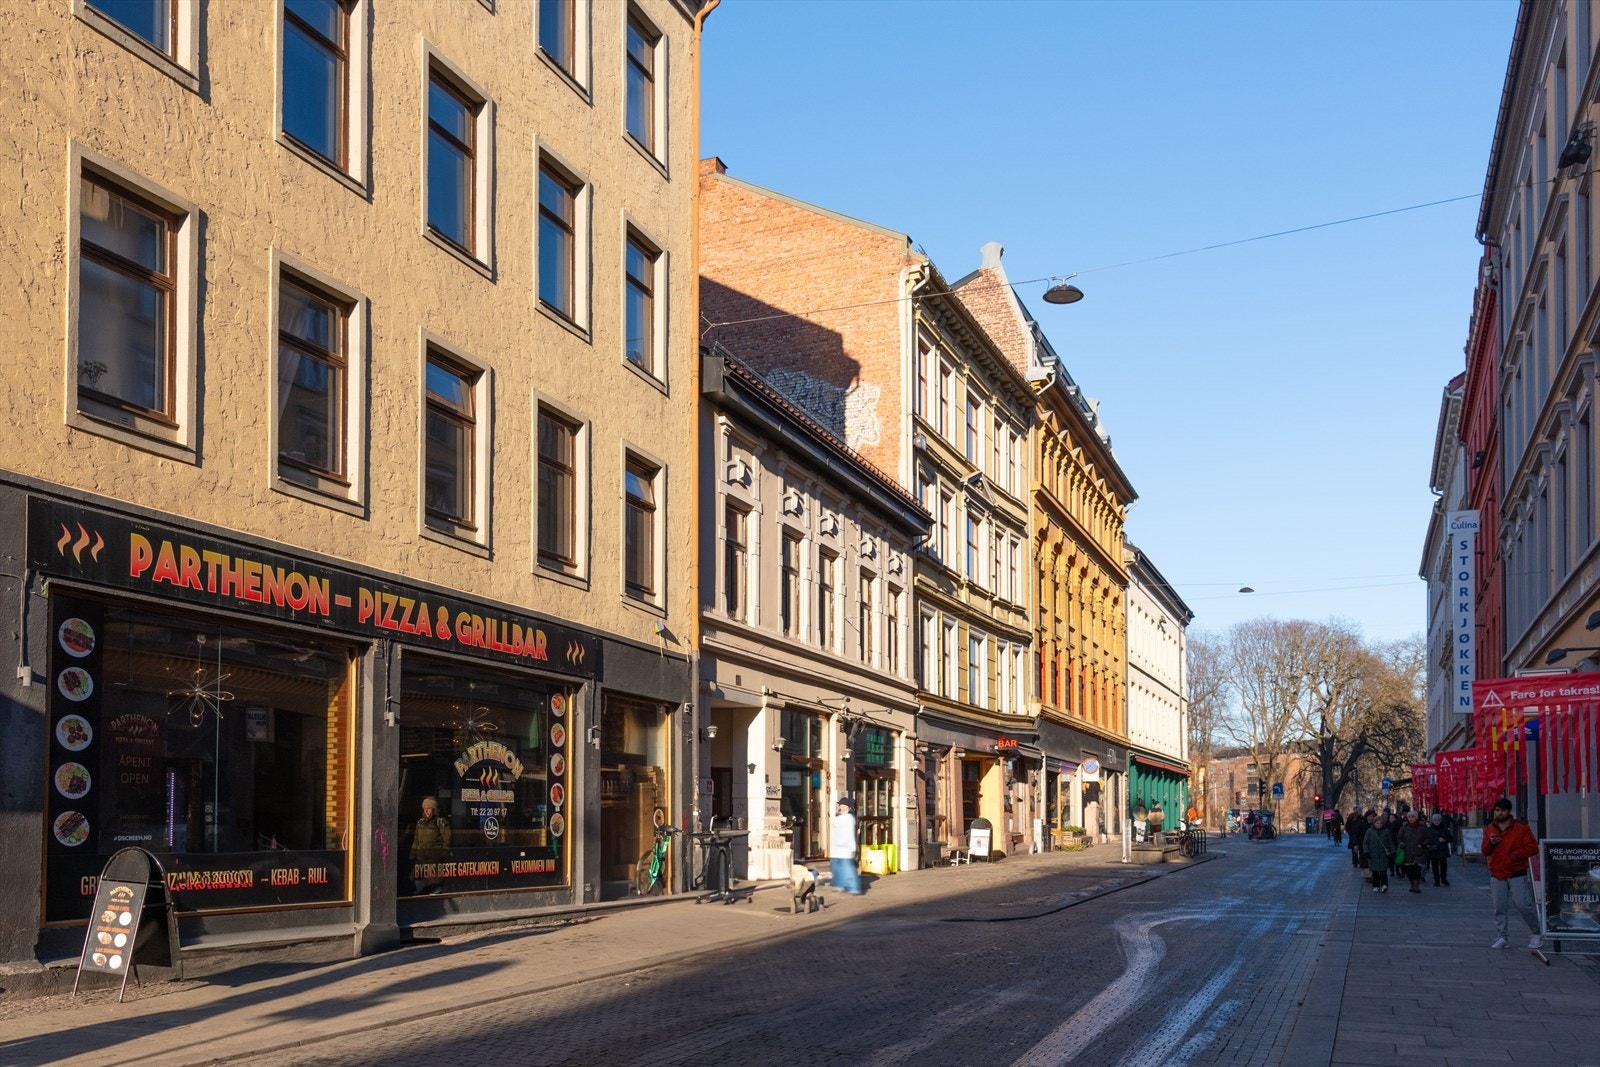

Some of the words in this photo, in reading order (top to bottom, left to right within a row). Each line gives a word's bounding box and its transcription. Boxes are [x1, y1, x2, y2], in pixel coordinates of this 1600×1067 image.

[1451, 521, 1477, 530] Culina
[130, 532, 330, 616] PARTHENON
[358, 587, 432, 637] PIZZA
[435, 606, 452, 640] &
[455, 611, 548, 661] GRILLBAR
[1458, 540, 1471, 706] STORKJØKKEN
[1510, 690, 1536, 700] Fare
[1540, 688, 1556, 697] for
[1559, 685, 1600, 696] takras!
[998, 740, 1018, 748] BAR
[454, 741, 525, 779] PARTHENON
[120, 773, 149, 784] OPEN
[480, 808, 487, 816] 22
[487, 808, 494, 816] 20
[494, 808, 500, 816] 97
[501, 808, 508, 816] 17
[271, 868, 299, 885] KEBAB
[308, 867, 328, 884] RULL
[414, 863, 436, 878] BYENS
[437, 862, 457, 877] BESTE
[457, 861, 500, 876] GATEKJØKKEN
[511, 860, 545, 873] VELKOMMEN
[545, 859, 555, 872] INN
